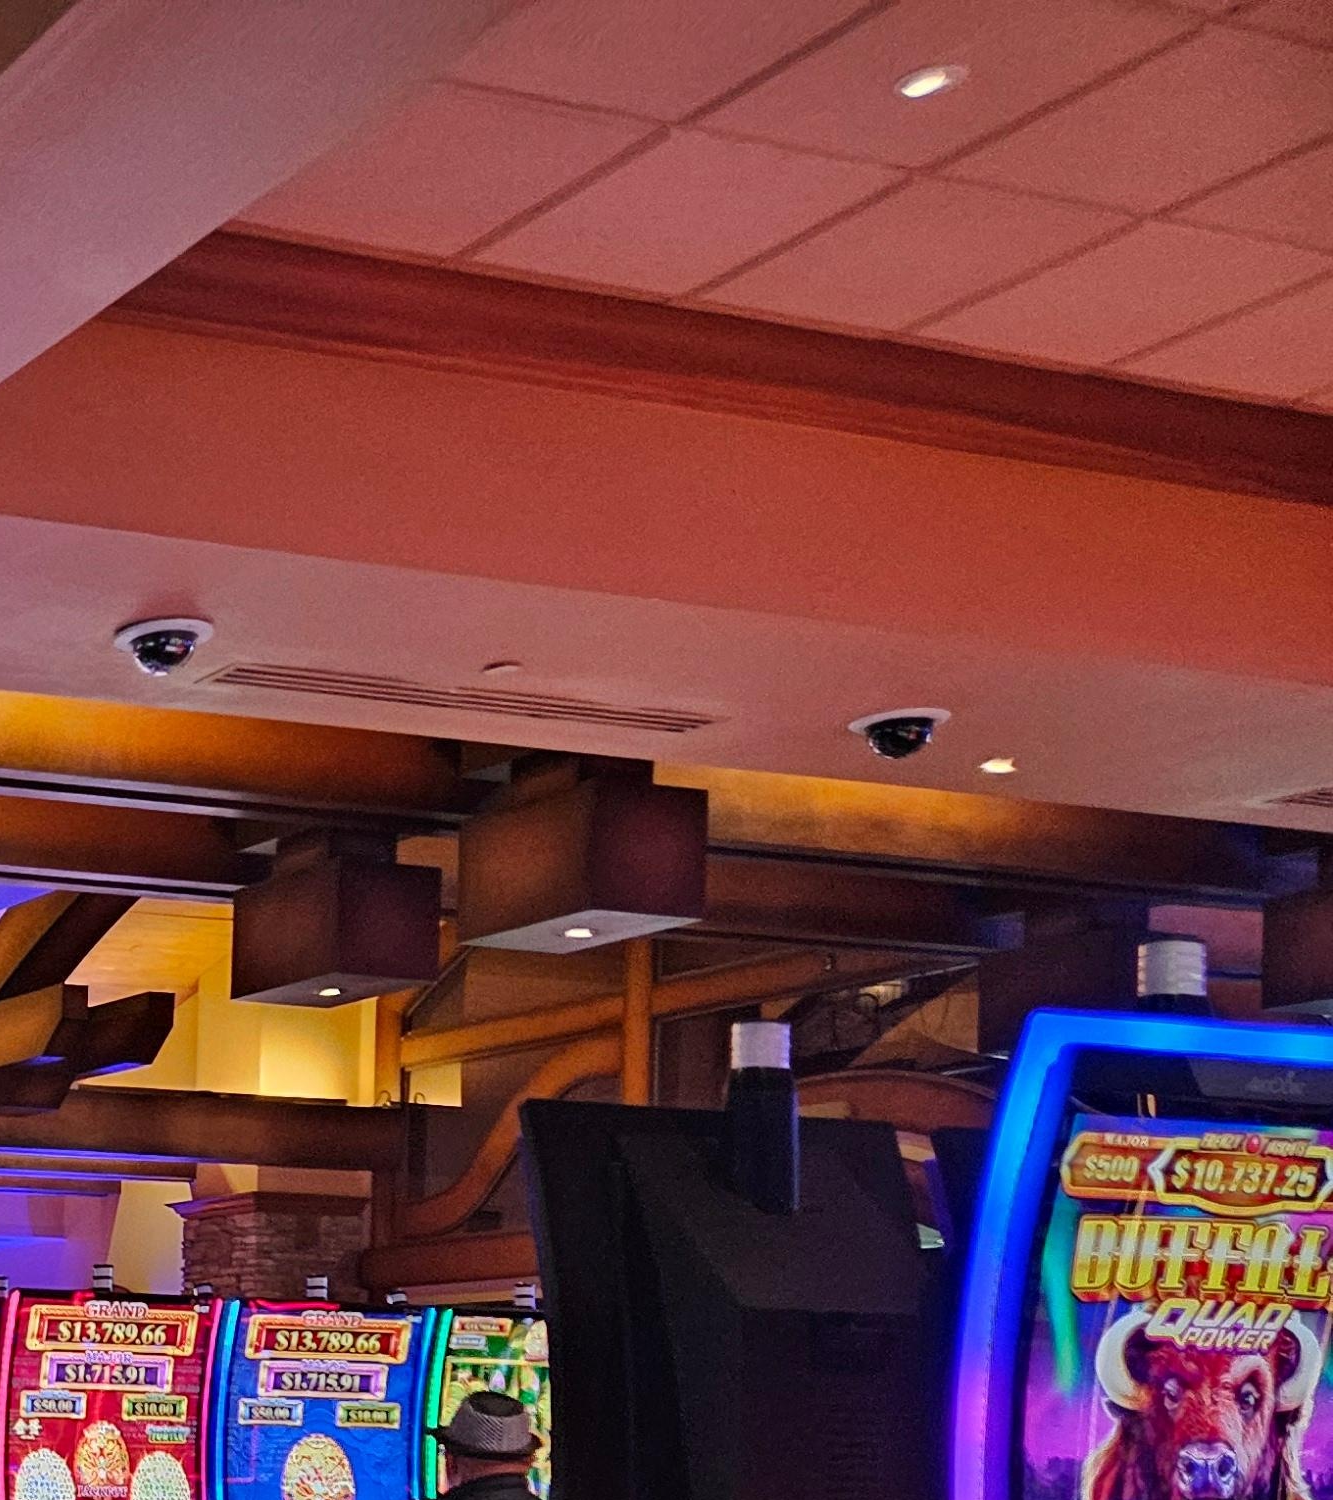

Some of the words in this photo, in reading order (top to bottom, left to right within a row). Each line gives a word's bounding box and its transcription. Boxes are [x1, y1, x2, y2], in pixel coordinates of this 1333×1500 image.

[1105, 1134, 1150, 1147] MAJOR
[1084, 1155, 1140, 1183] $500
[1171, 1156, 1318, 1198] $10,737.25
[1071, 1216, 1333, 1300] BUFFAL
[86, 1303, 147, 1318] GRAND
[303, 1313, 362, 1327] GRAND
[58, 1321, 167, 1346] $13,789.66
[1145, 1300, 1298, 1348] QUAD
[275, 1330, 381, 1354] $13,789.66
[1185, 1327, 1278, 1351] POWER
[65, 1364, 147, 1385] $1,715.91
[281, 1372, 360, 1392] $1,715.91
[33, 1399, 73, 1412] $50.00
